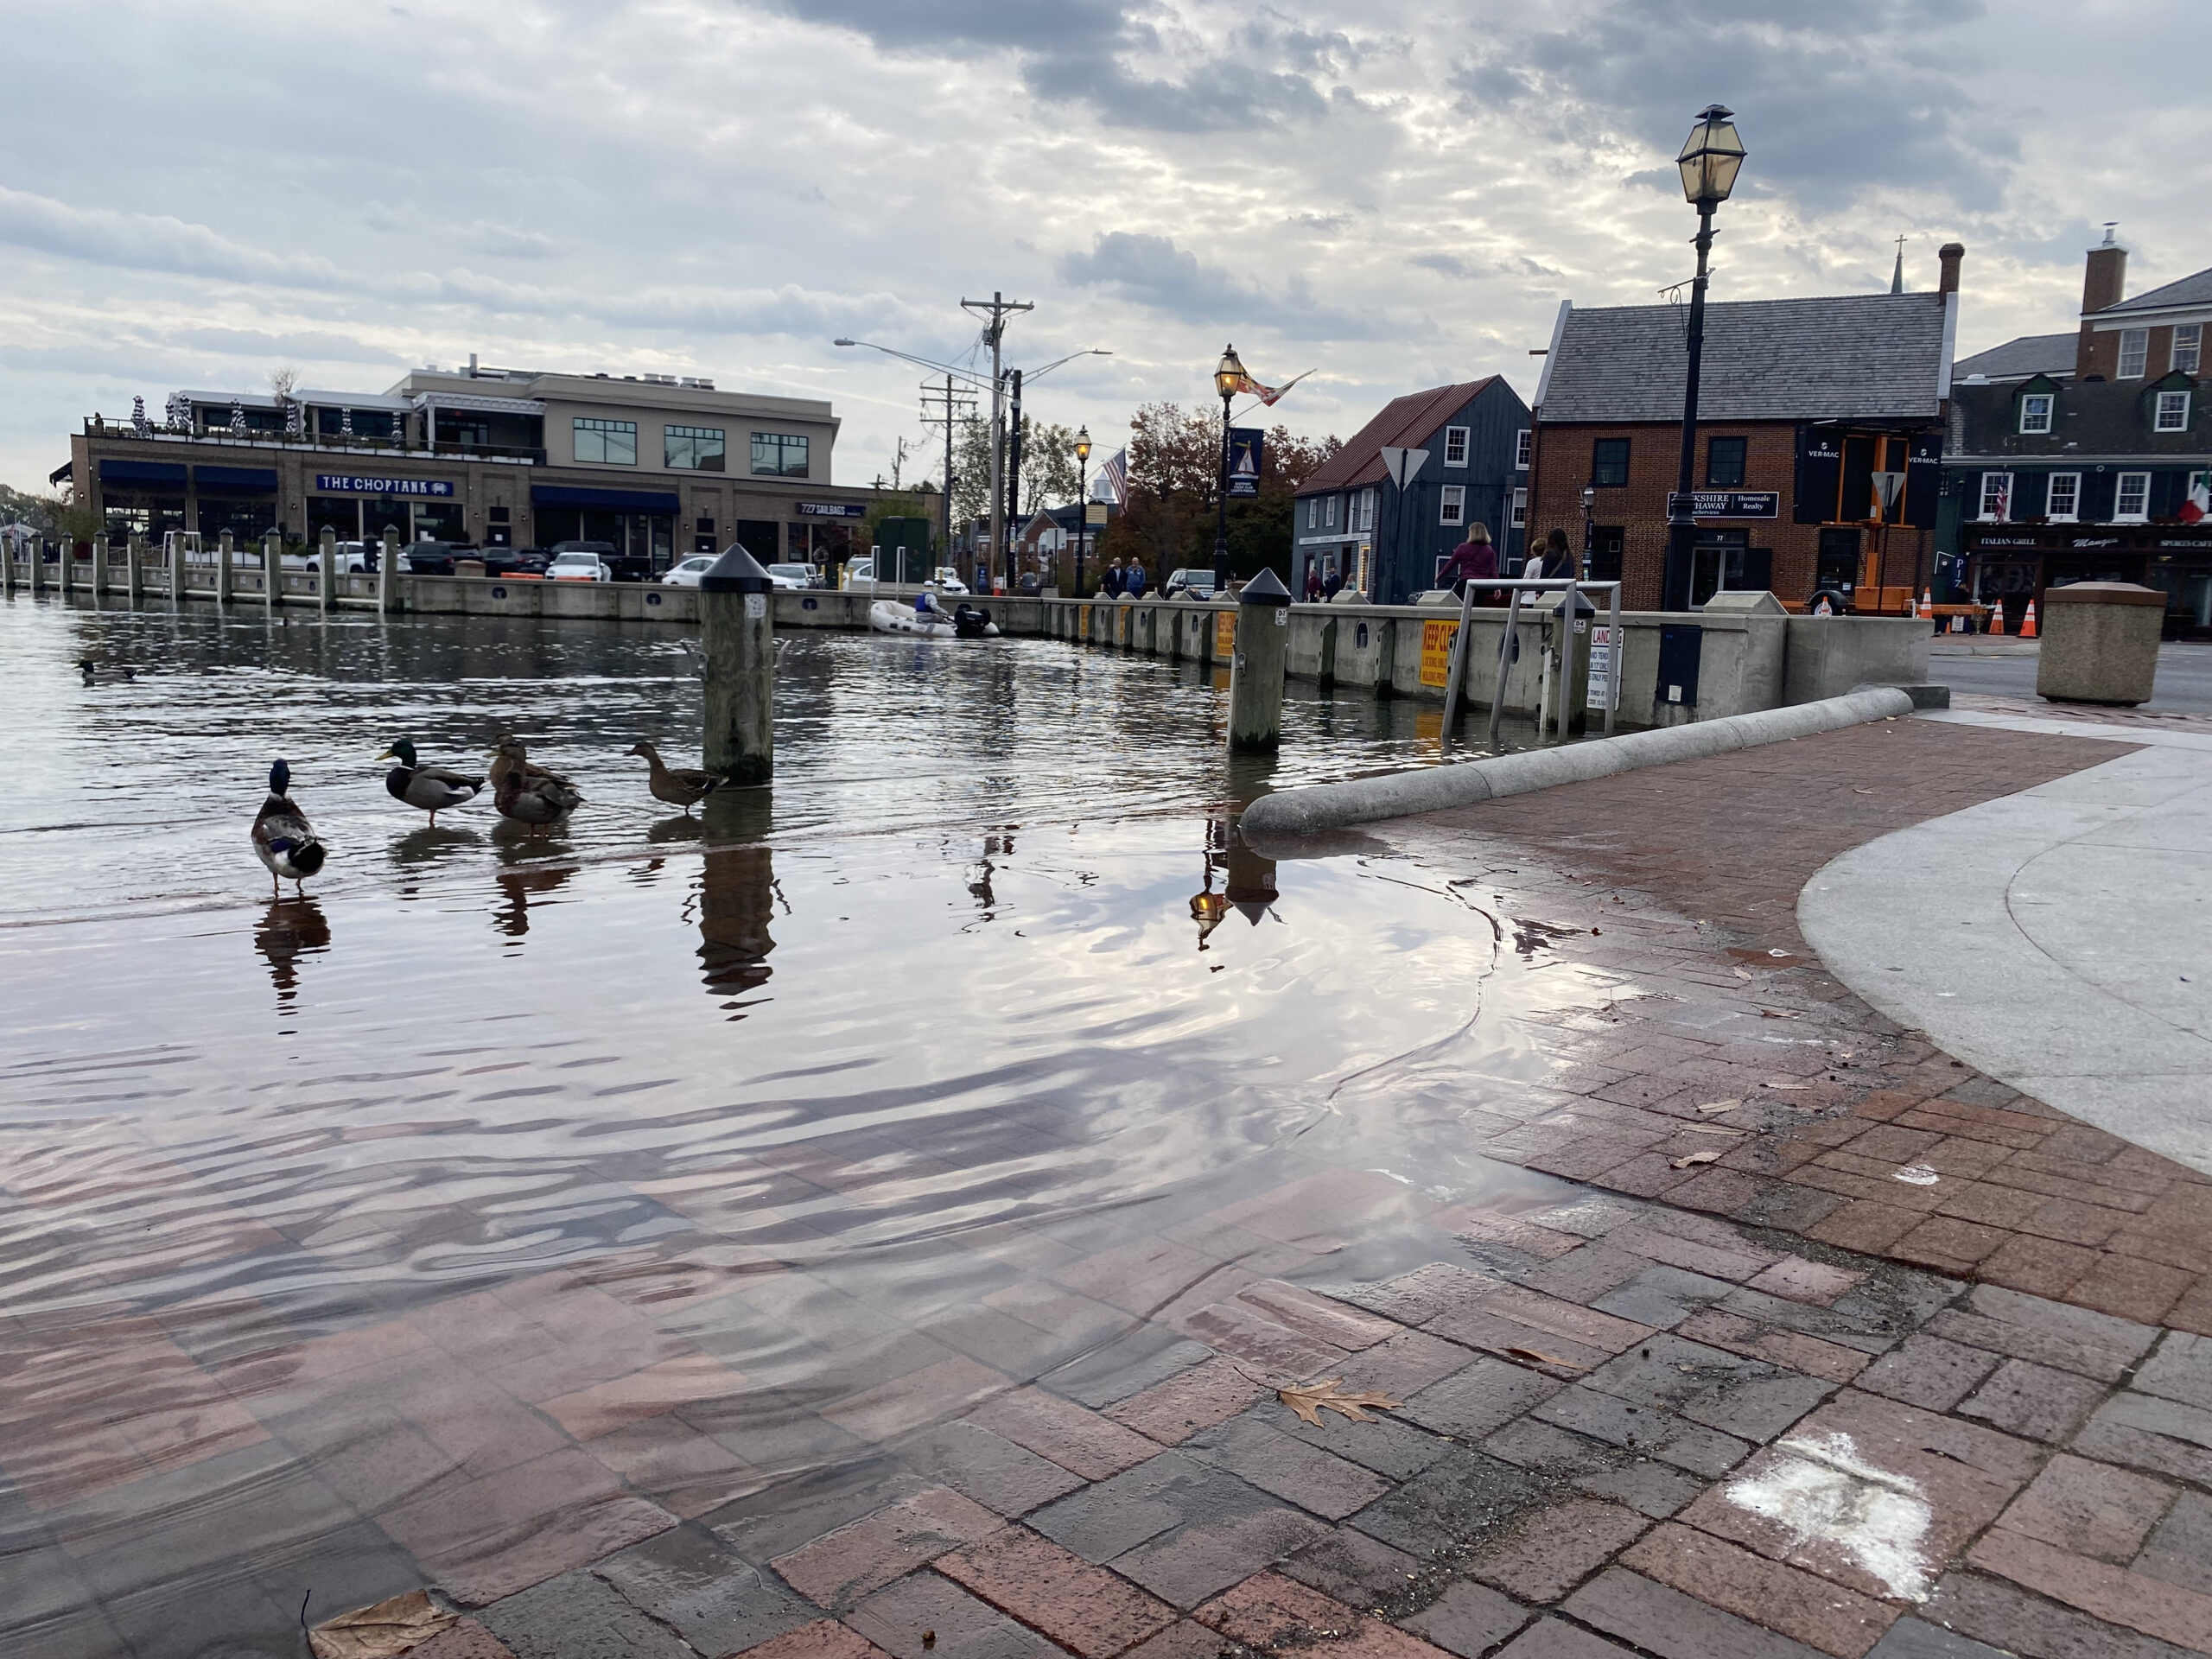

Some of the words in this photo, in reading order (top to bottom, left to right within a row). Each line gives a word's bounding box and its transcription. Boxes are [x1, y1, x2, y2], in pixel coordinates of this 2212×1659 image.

[323, 476, 349, 489] THE
[354, 478, 427, 493] CHOPTANK
[817, 505, 845, 515] SAILBAGS
[1422, 624, 1439, 651] KEEP
[1592, 629, 1623, 644] LANDG
